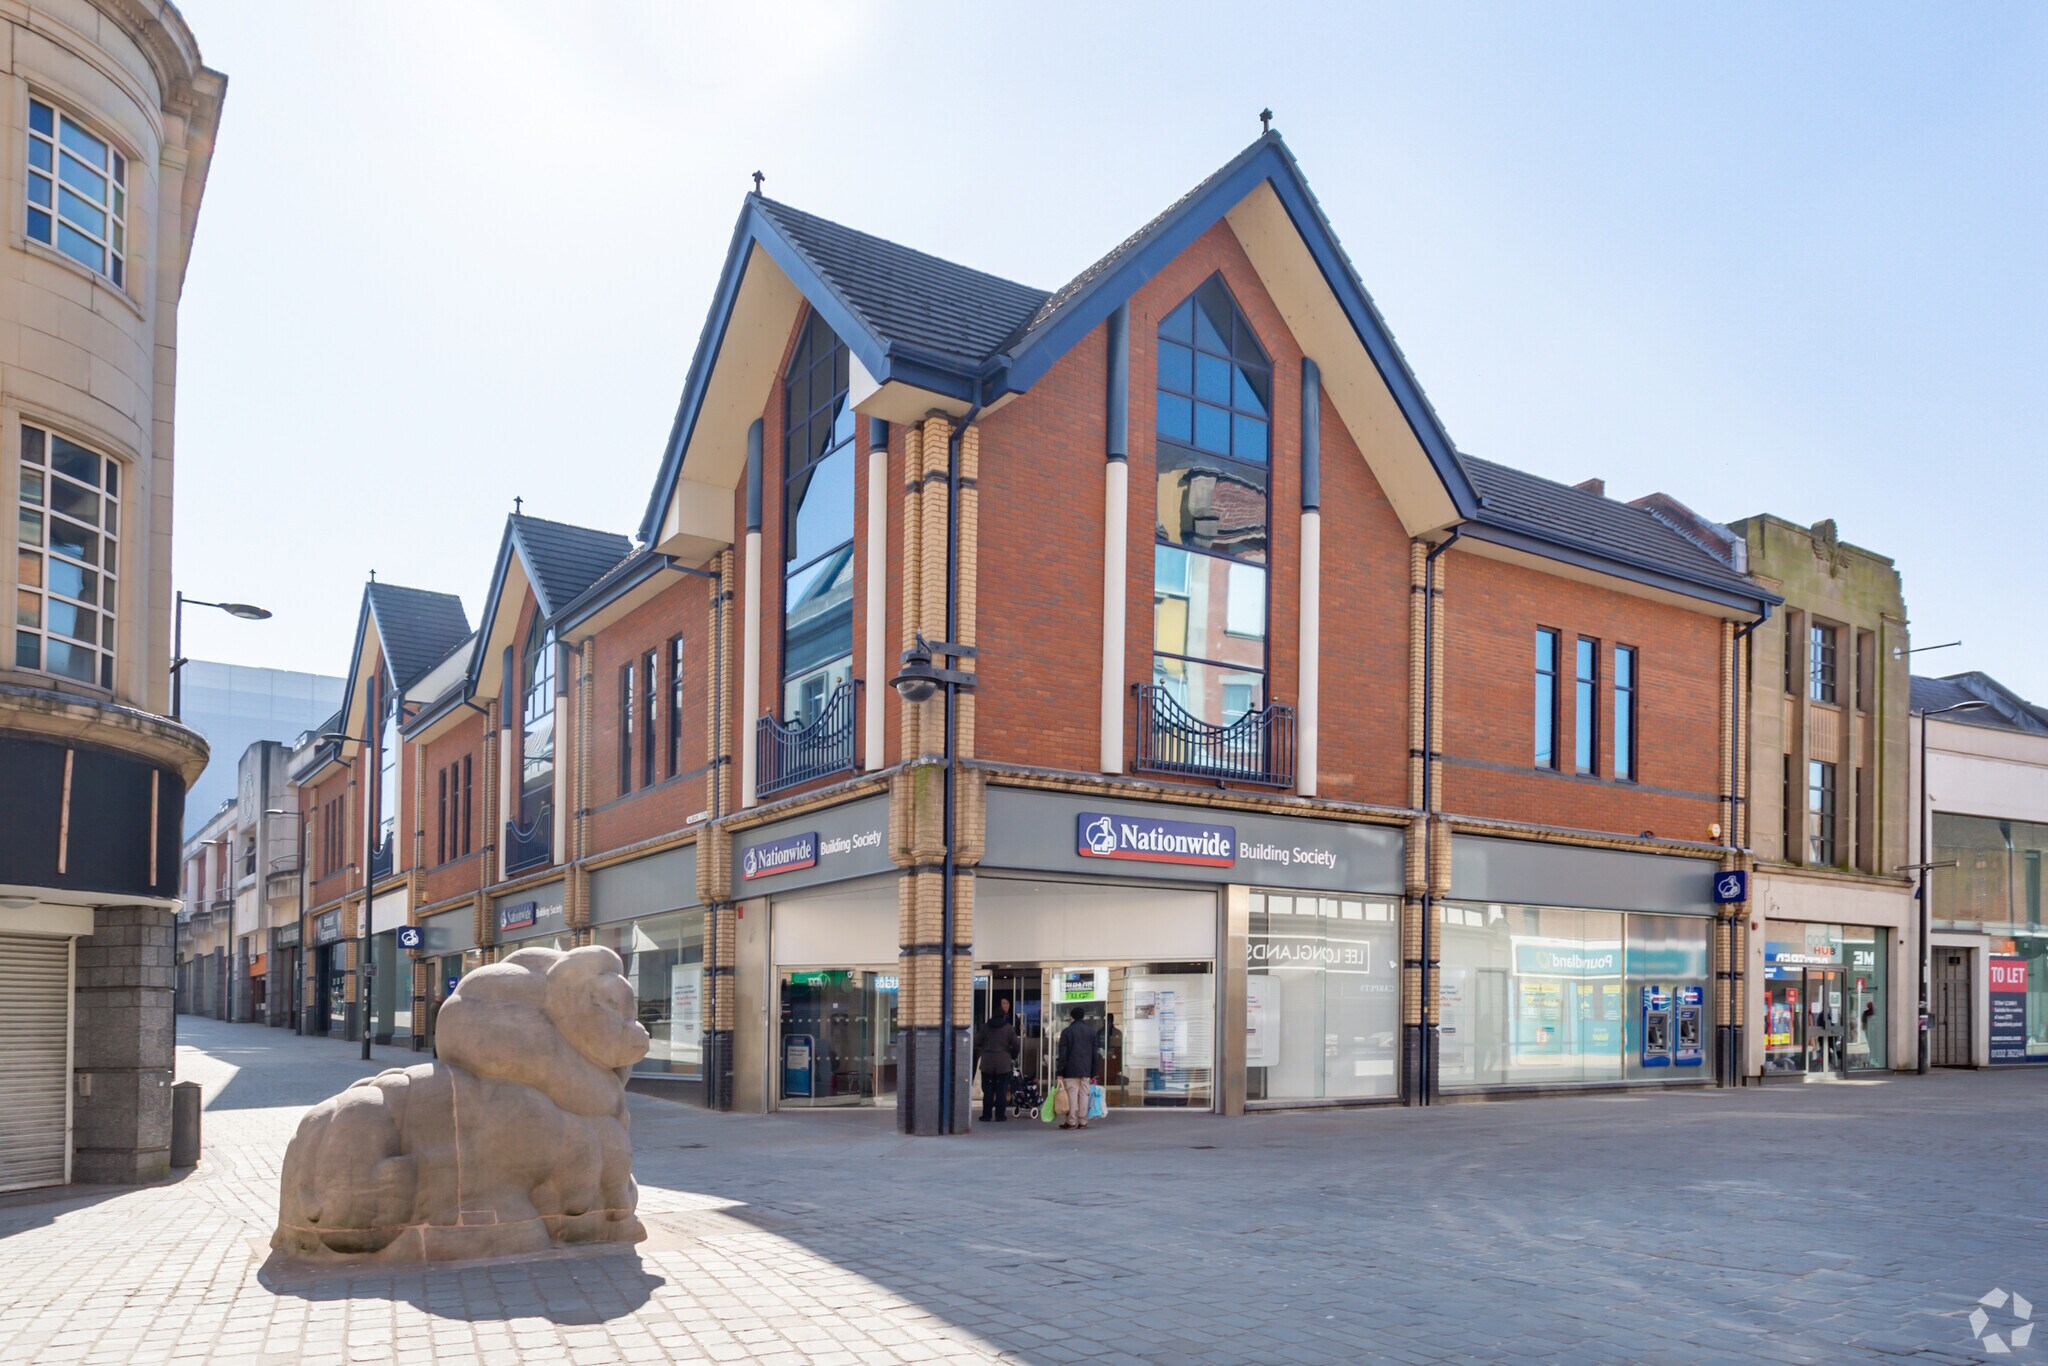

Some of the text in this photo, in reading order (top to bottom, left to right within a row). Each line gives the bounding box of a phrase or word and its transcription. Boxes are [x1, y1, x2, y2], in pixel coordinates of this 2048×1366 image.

[758, 830, 882, 869] Nationwide Building Society
[1120, 824, 1337, 869] Nationwide Building Society
[507, 906, 532, 924] Nationwide
[1813, 946, 1836, 956] HUB
[1991, 966, 2025, 984] TO LET
